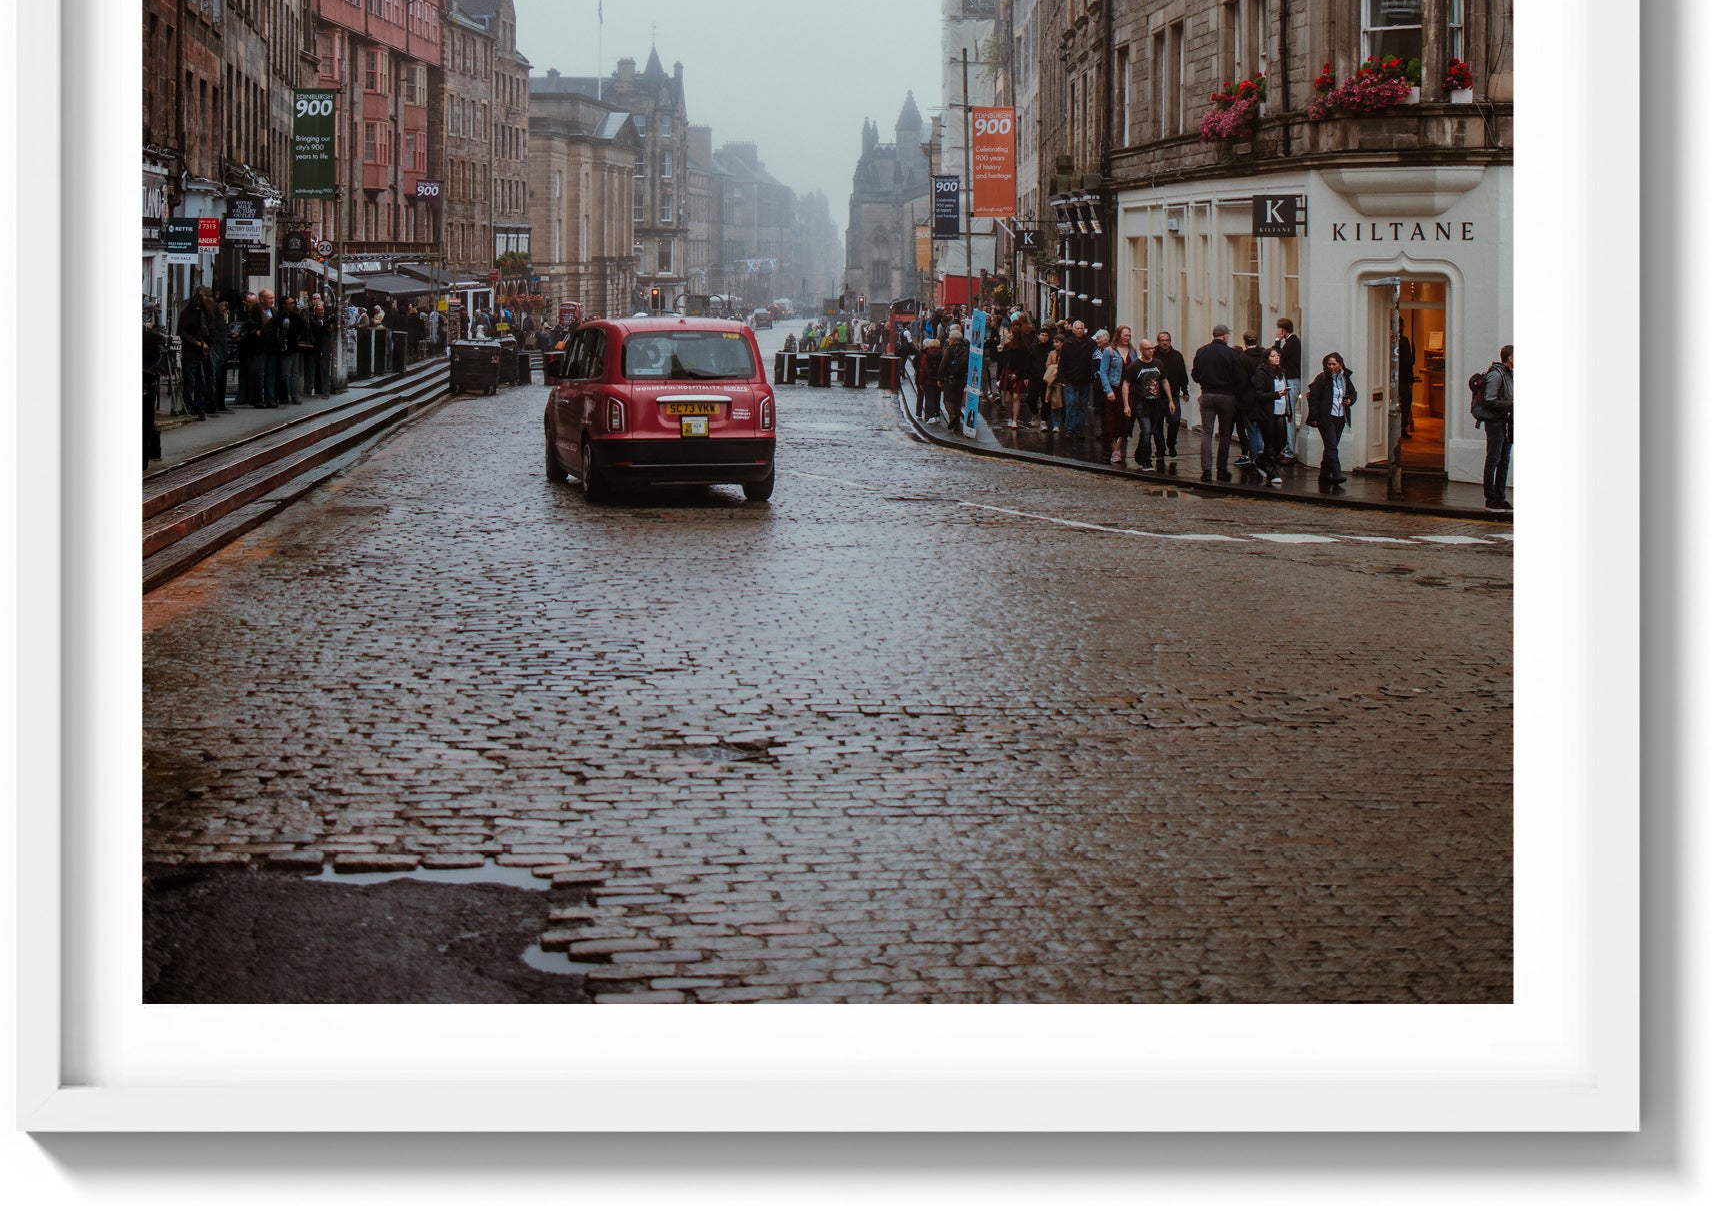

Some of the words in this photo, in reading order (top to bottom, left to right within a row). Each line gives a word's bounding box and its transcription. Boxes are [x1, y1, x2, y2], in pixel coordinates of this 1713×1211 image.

[295, 99, 333, 118] 900
[974, 118, 1011, 137] 900
[295, 135, 320, 144] Bringing
[975, 146, 1008, 154] Celebrating
[983, 163, 1002, 171] history
[988, 173, 1012, 181] heritage
[417, 186, 439, 196] 900
[936, 181, 958, 193] 900
[1265, 199, 1285, 224] K
[1332, 221, 1475, 242] KILTANE
[1024, 232, 1034, 245] K
[319, 244, 332, 252] 20
[670, 403, 695, 413] SC73
